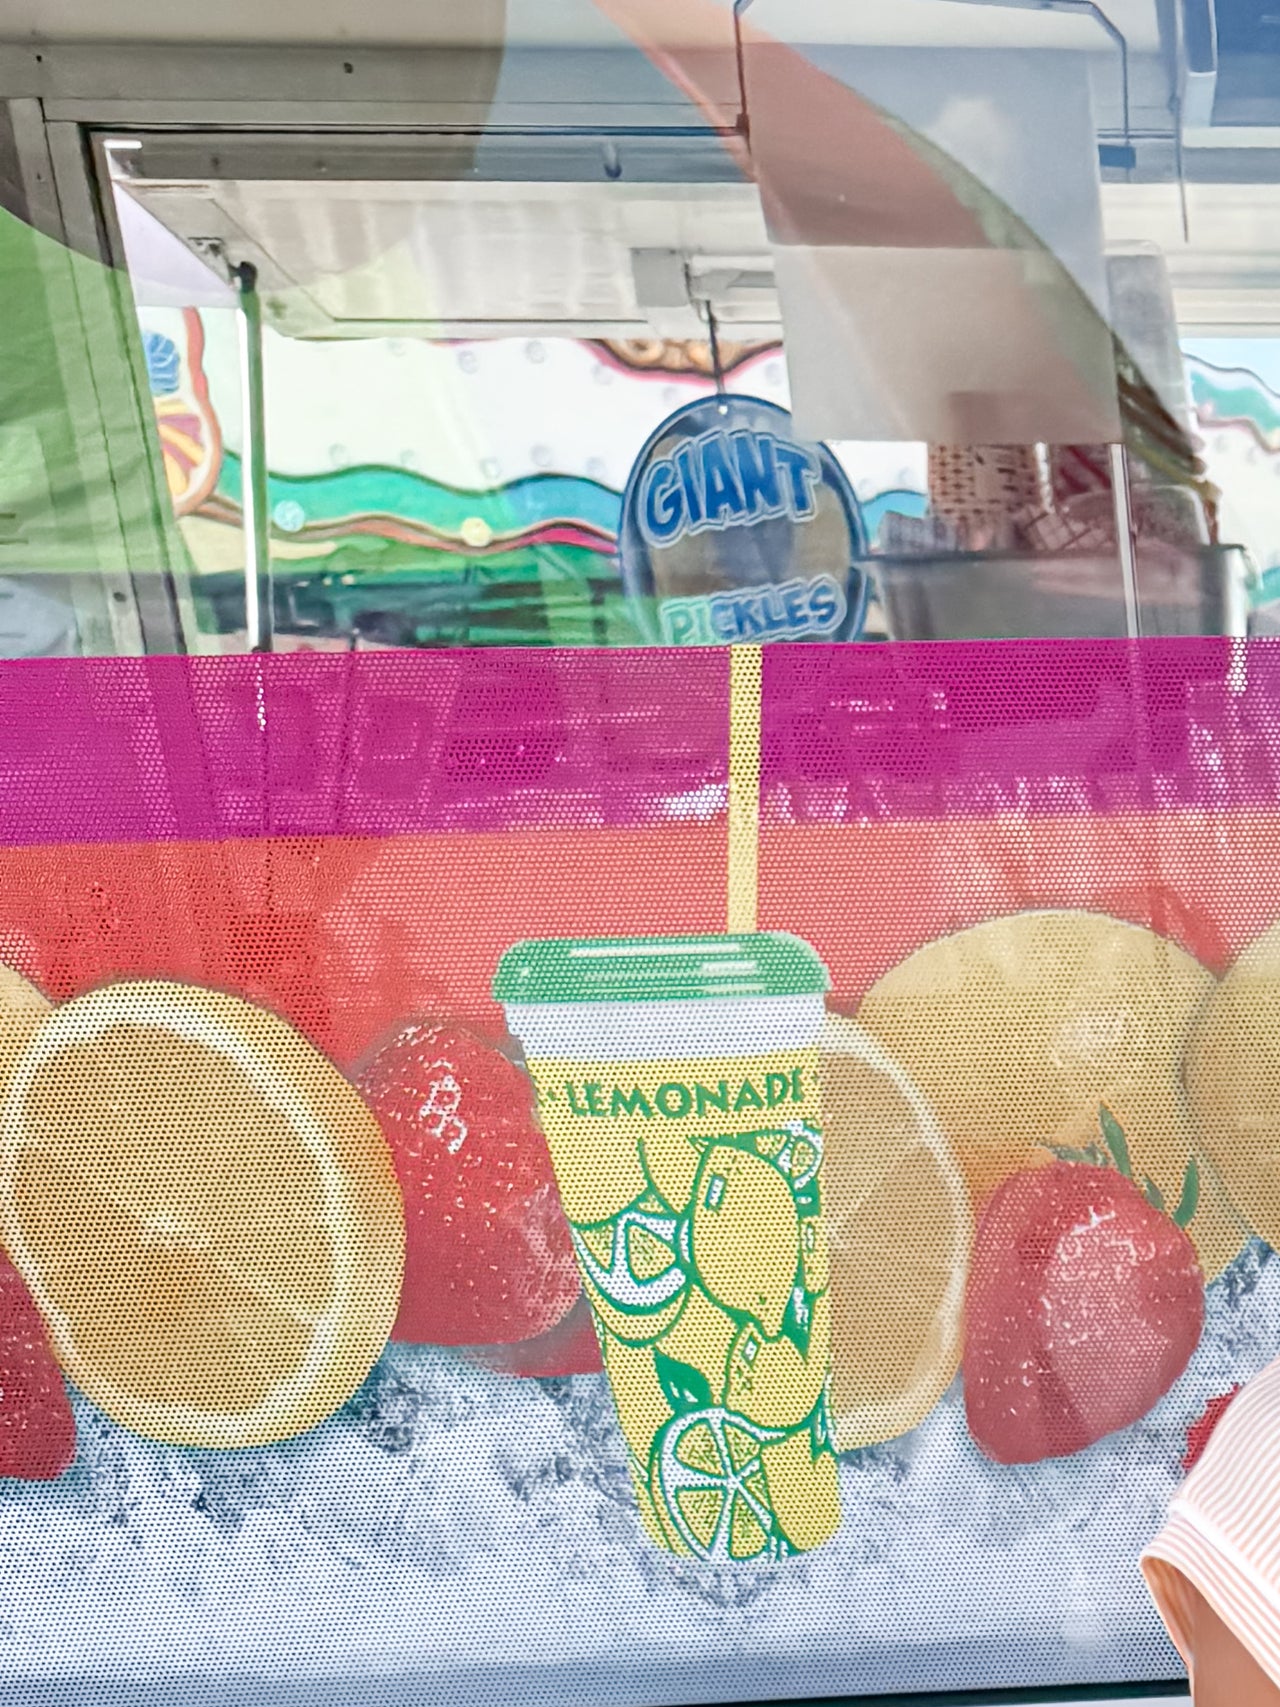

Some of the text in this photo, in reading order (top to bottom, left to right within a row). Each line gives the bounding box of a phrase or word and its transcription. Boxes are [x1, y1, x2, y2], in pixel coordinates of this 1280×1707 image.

[640, 429, 818, 545] GIANT
[661, 575, 845, 643] PICKLES
[564, 1067, 804, 1120] LEMONADE
